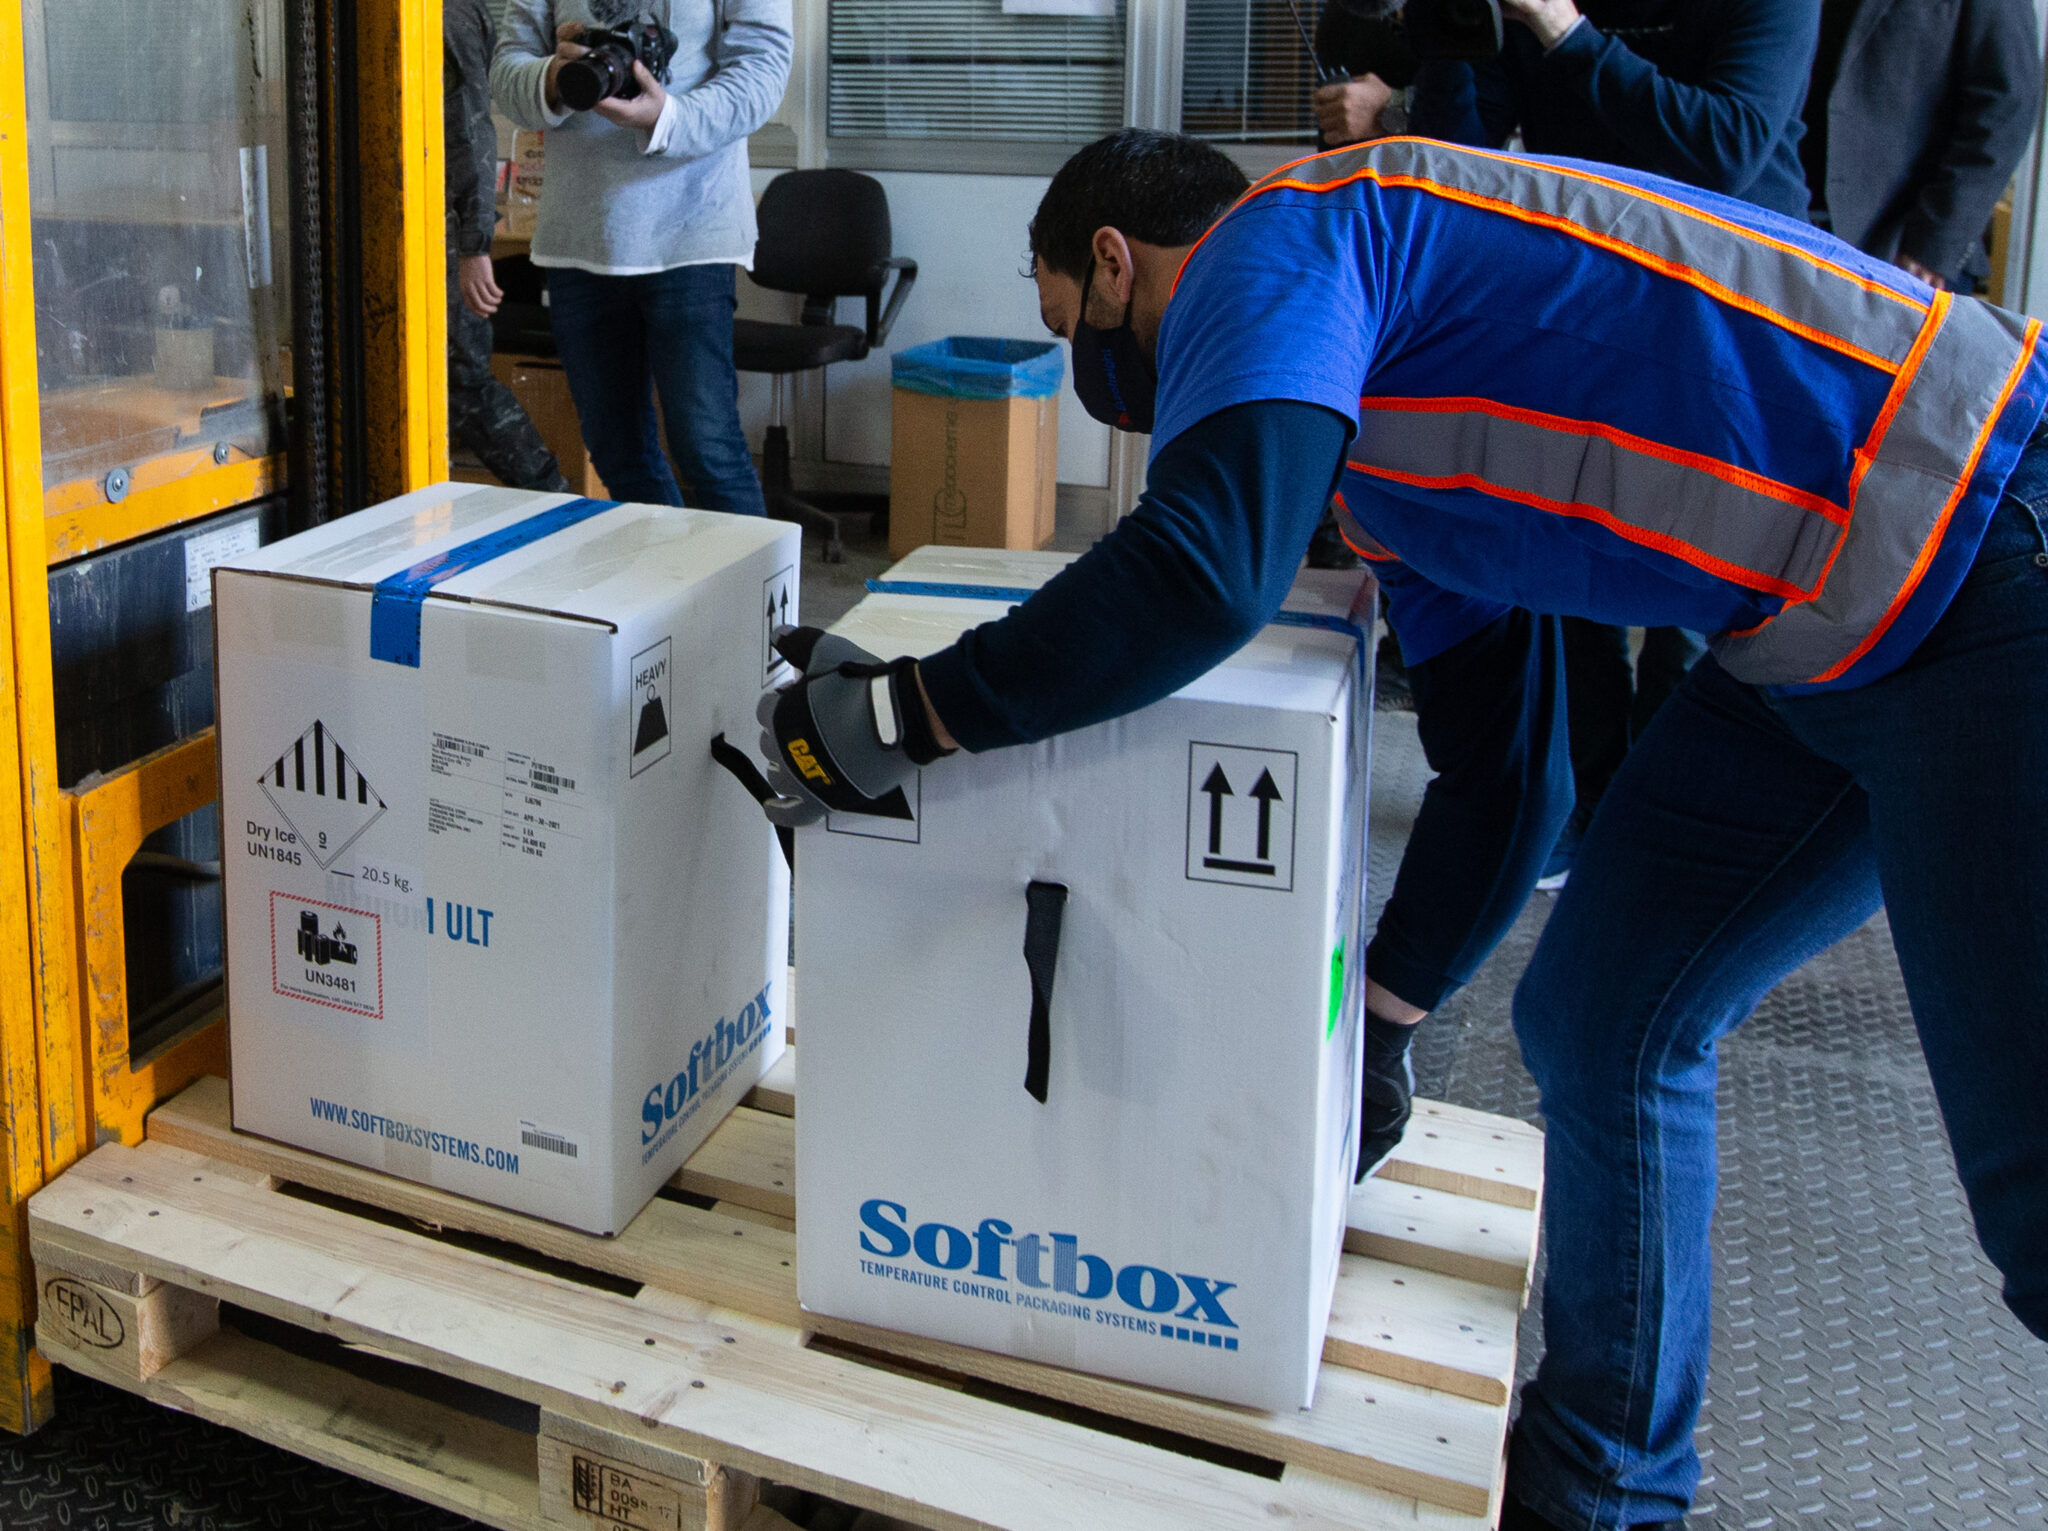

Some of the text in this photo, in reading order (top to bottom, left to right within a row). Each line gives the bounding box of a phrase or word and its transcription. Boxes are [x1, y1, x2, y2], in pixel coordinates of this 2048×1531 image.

[635, 658, 667, 691] HEAVY
[788, 738, 828, 780] CAT
[246, 820, 297, 844] Dry Ice
[318, 832, 327, 846] 9
[247, 842, 302, 866] UN1845
[362, 866, 413, 893] 20.5 kg.
[446, 901, 494, 947] ULT
[305, 968, 356, 993] UN3481
[641, 980, 772, 1146] Softbox
[309, 1096, 520, 1176] WWW.SOFTBOXSYSTEMS.COM
[858, 1198, 1239, 1329] Softbox
[859, 1258, 1158, 1336] TEMPERATURE CONTROL PACKAGING SYSTEMS
[610, 1472, 632, 1492] BA
[609, 1503, 632, 1520] HT
